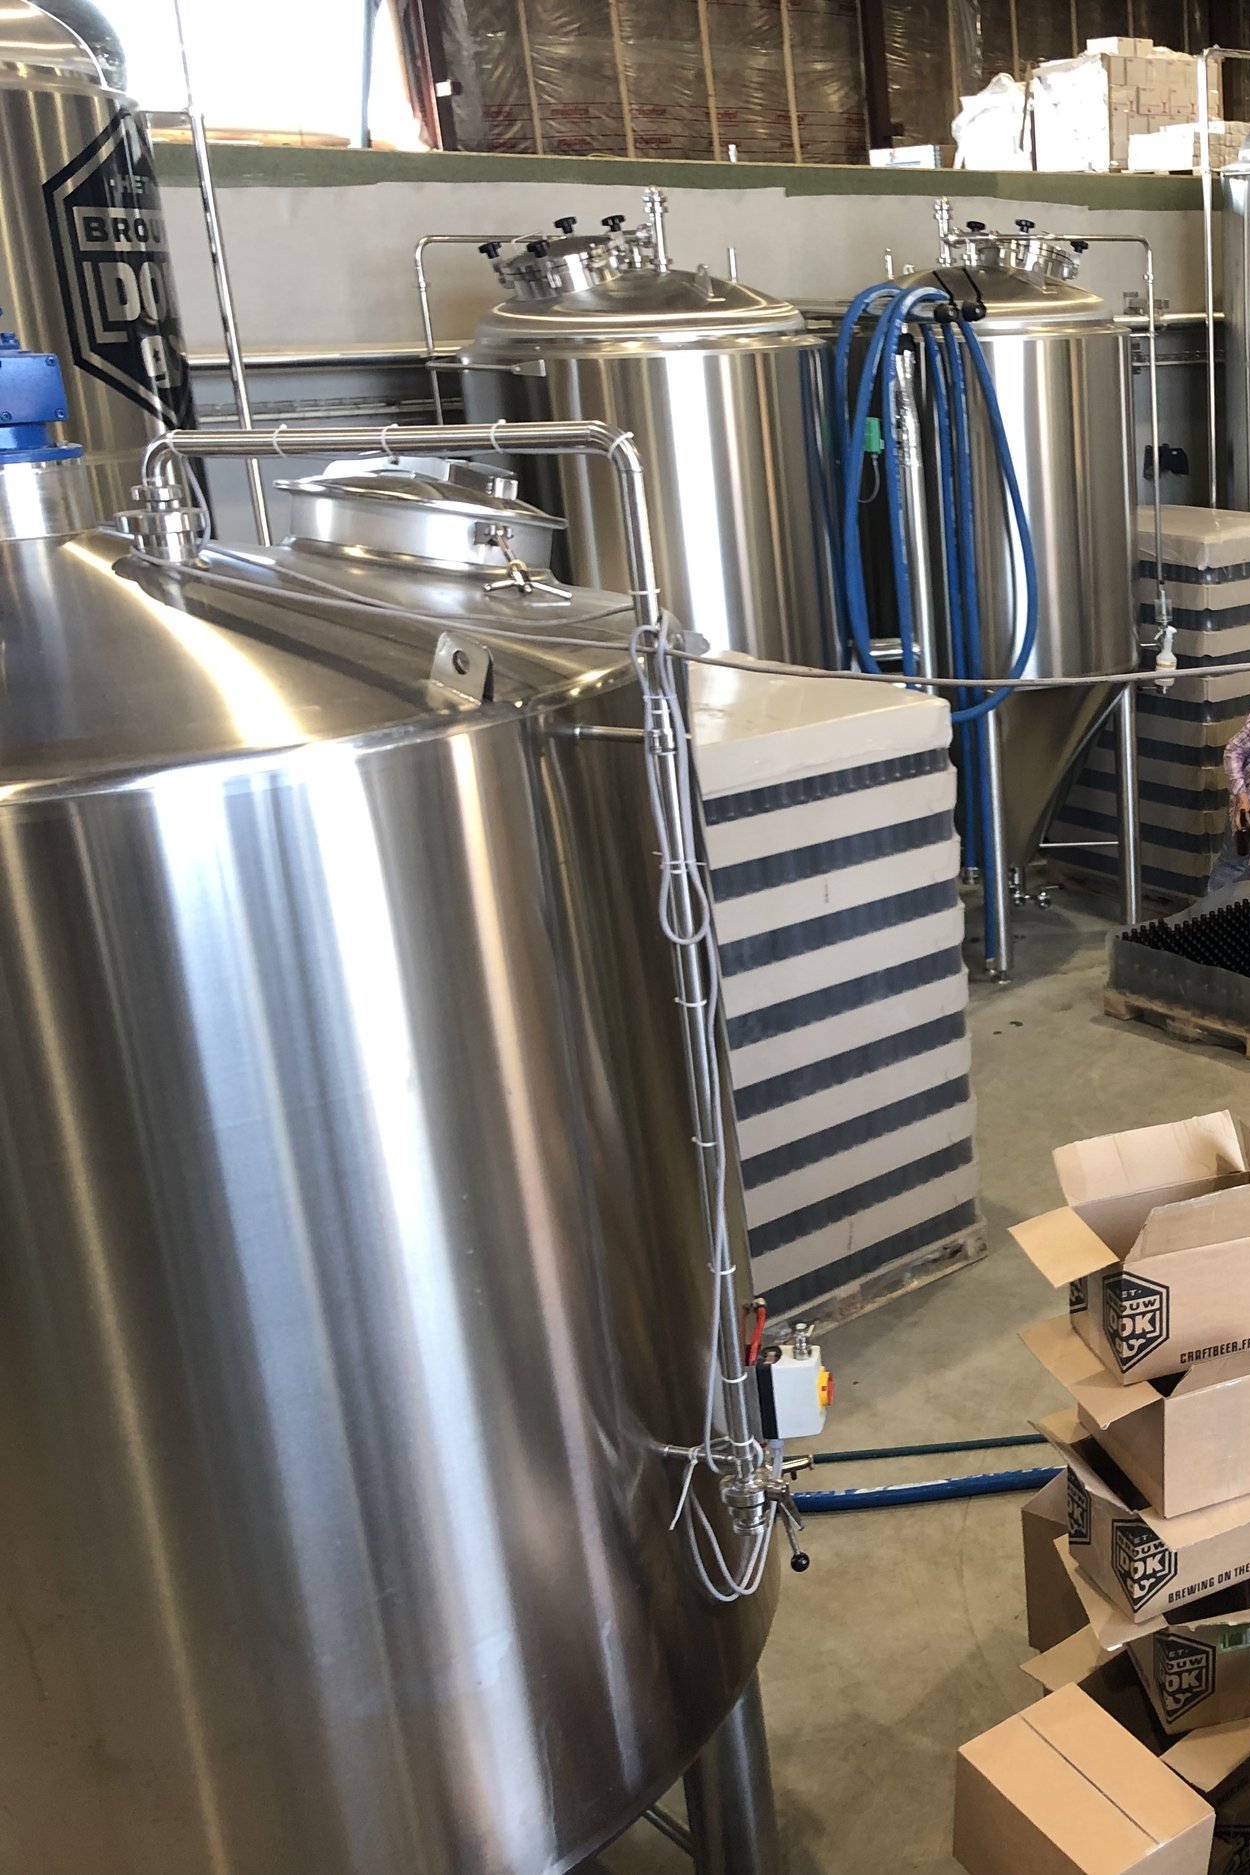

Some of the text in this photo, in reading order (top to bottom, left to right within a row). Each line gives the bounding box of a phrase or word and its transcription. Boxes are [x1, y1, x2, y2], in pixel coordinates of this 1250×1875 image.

[1168, 1577, 1215, 1604] BREWING
[1218, 1570, 1232, 1585] ON
[1234, 1563, 1250, 1578] THE
